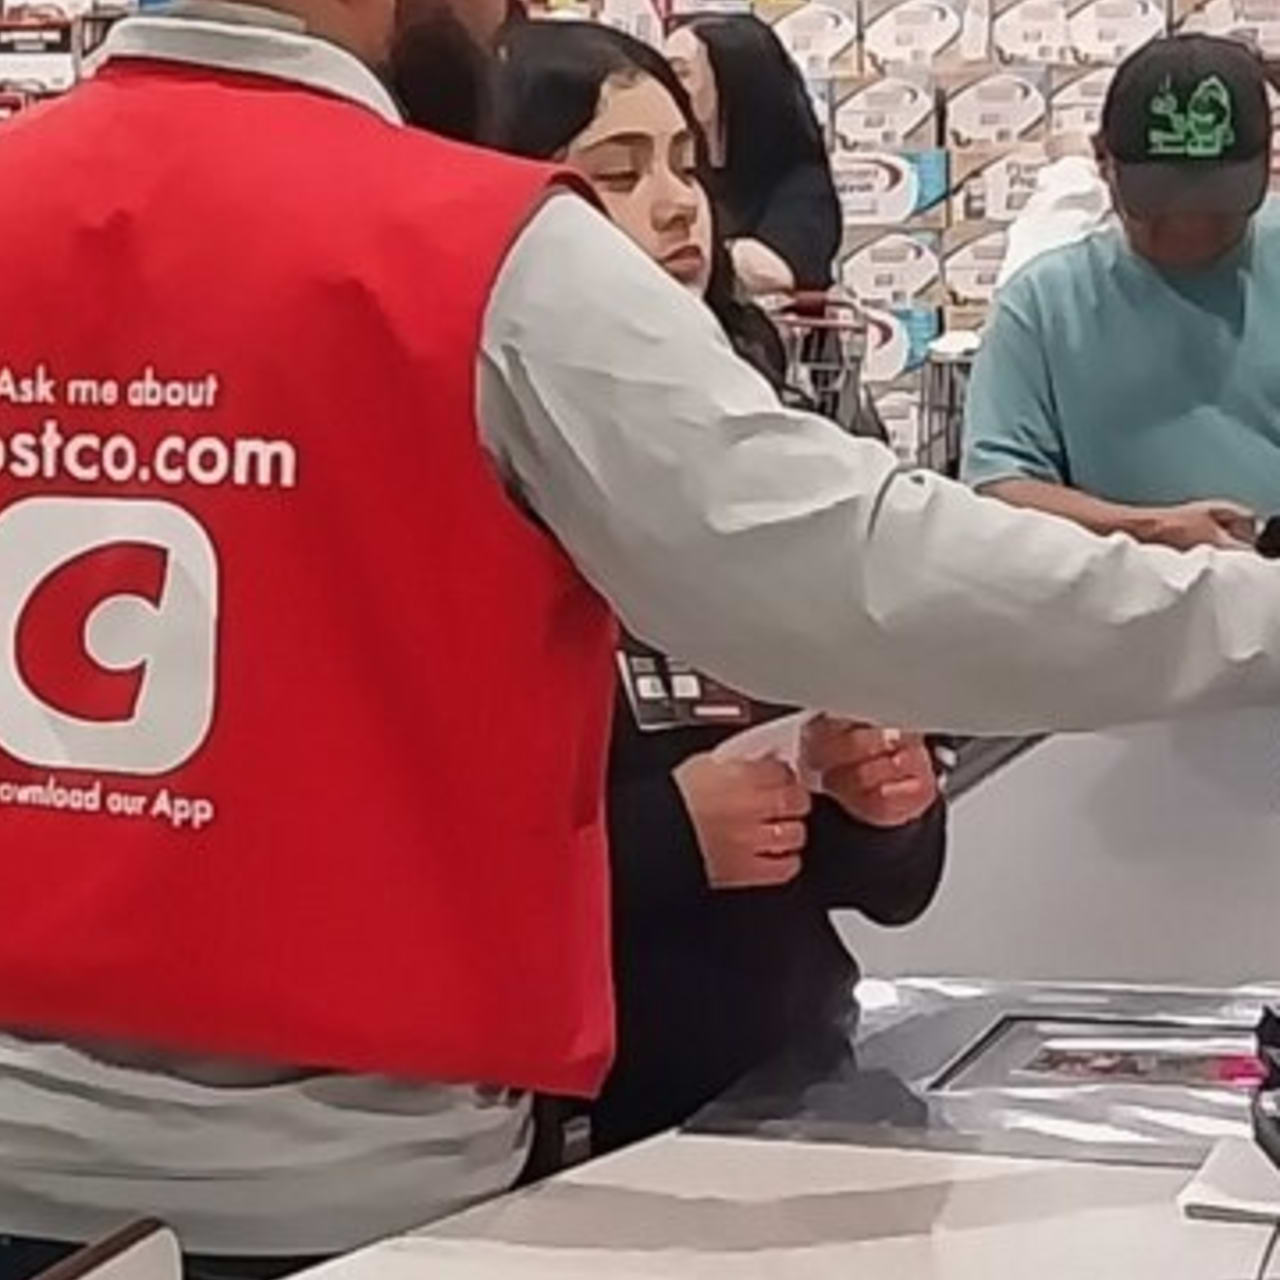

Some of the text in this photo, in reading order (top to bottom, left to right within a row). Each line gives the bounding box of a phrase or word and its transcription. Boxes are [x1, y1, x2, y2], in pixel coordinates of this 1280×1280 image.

[67, 378, 119, 405] me
[127, 366, 219, 407] about
[14, 540, 169, 723] C
[106, 791, 147, 815] our
[150, 787, 215, 829] App
